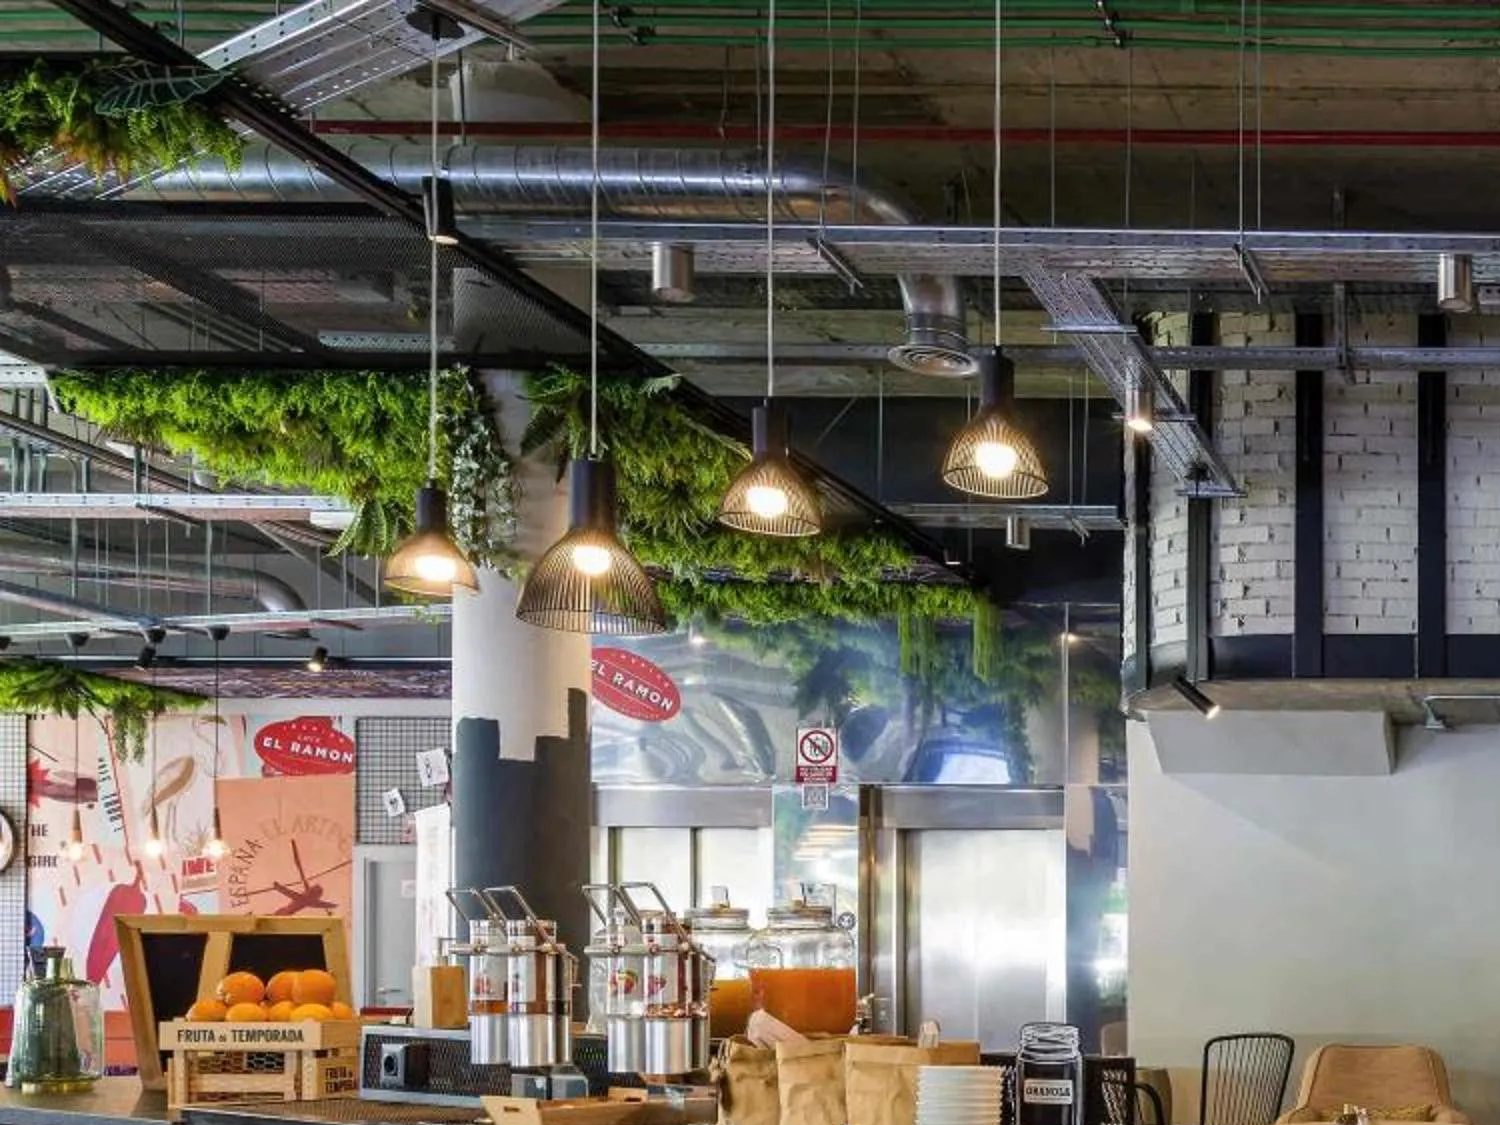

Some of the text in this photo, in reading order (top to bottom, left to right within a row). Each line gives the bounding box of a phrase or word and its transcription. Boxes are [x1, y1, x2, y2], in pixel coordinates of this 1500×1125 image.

[611, 672, 673, 711] RAMON
[262, 737, 282, 750] EL
[290, 741, 353, 764] RAMON
[177, 1029, 215, 1043] FRUTA
[231, 1029, 304, 1043] TEMPORADA
[1025, 1086, 1071, 1097] GRANOLA
